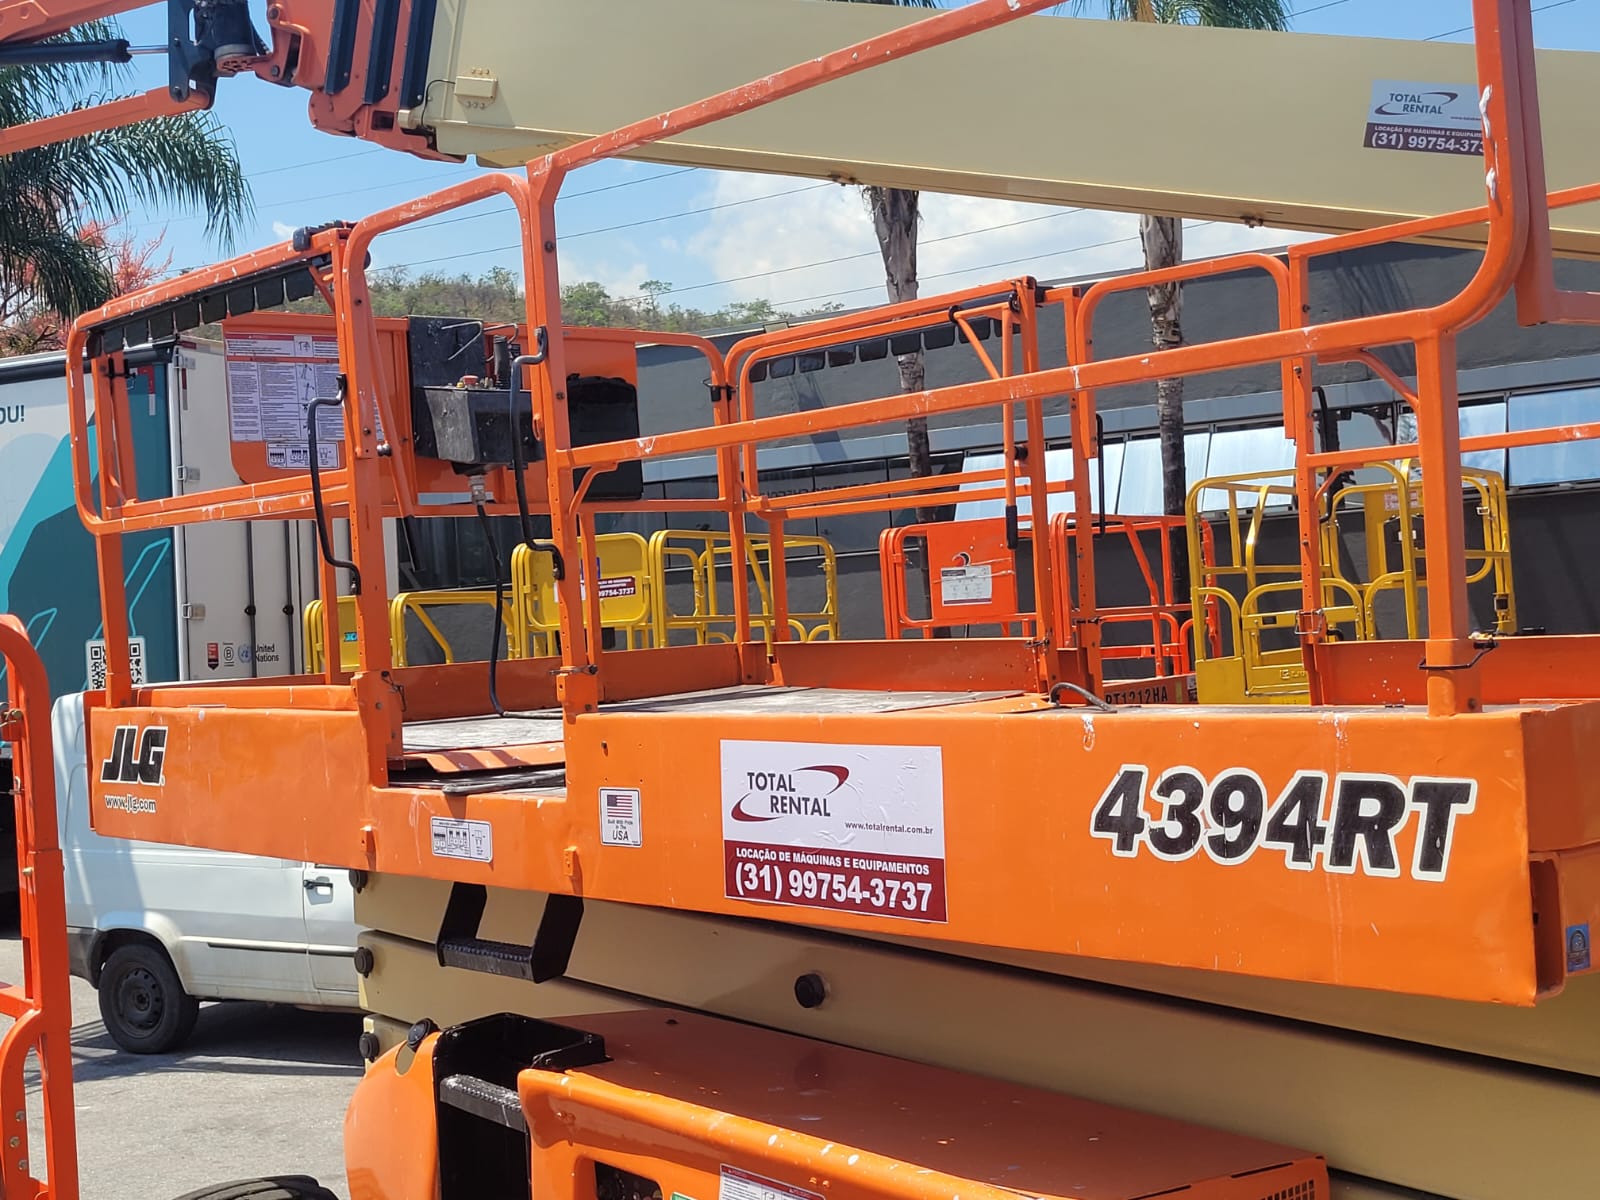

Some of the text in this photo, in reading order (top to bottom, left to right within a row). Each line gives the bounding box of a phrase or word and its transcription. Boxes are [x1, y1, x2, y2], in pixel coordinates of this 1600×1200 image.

[1389, 92, 1422, 104] TOTAL
[1402, 104, 1443, 115] RENTAL
[1371, 132, 1484, 153] (31) 99754-37
[598, 587, 634, 597] 9754-3737
[101, 725, 168, 786] JLG
[747, 771, 796, 793] TOTAL
[104, 794, 156, 814] www.jlg.com
[769, 794, 831, 817] RENTAL
[845, 820, 934, 835] www.totalrental.com.br
[1090, 764, 1478, 882] 4394RT
[612, 830, 629, 840] USA
[736, 848, 930, 876] LOCAÇÃO DE MÁQUINAS E EQUIPAMENTOS
[735, 862, 932, 912] (31) 99754-3737
